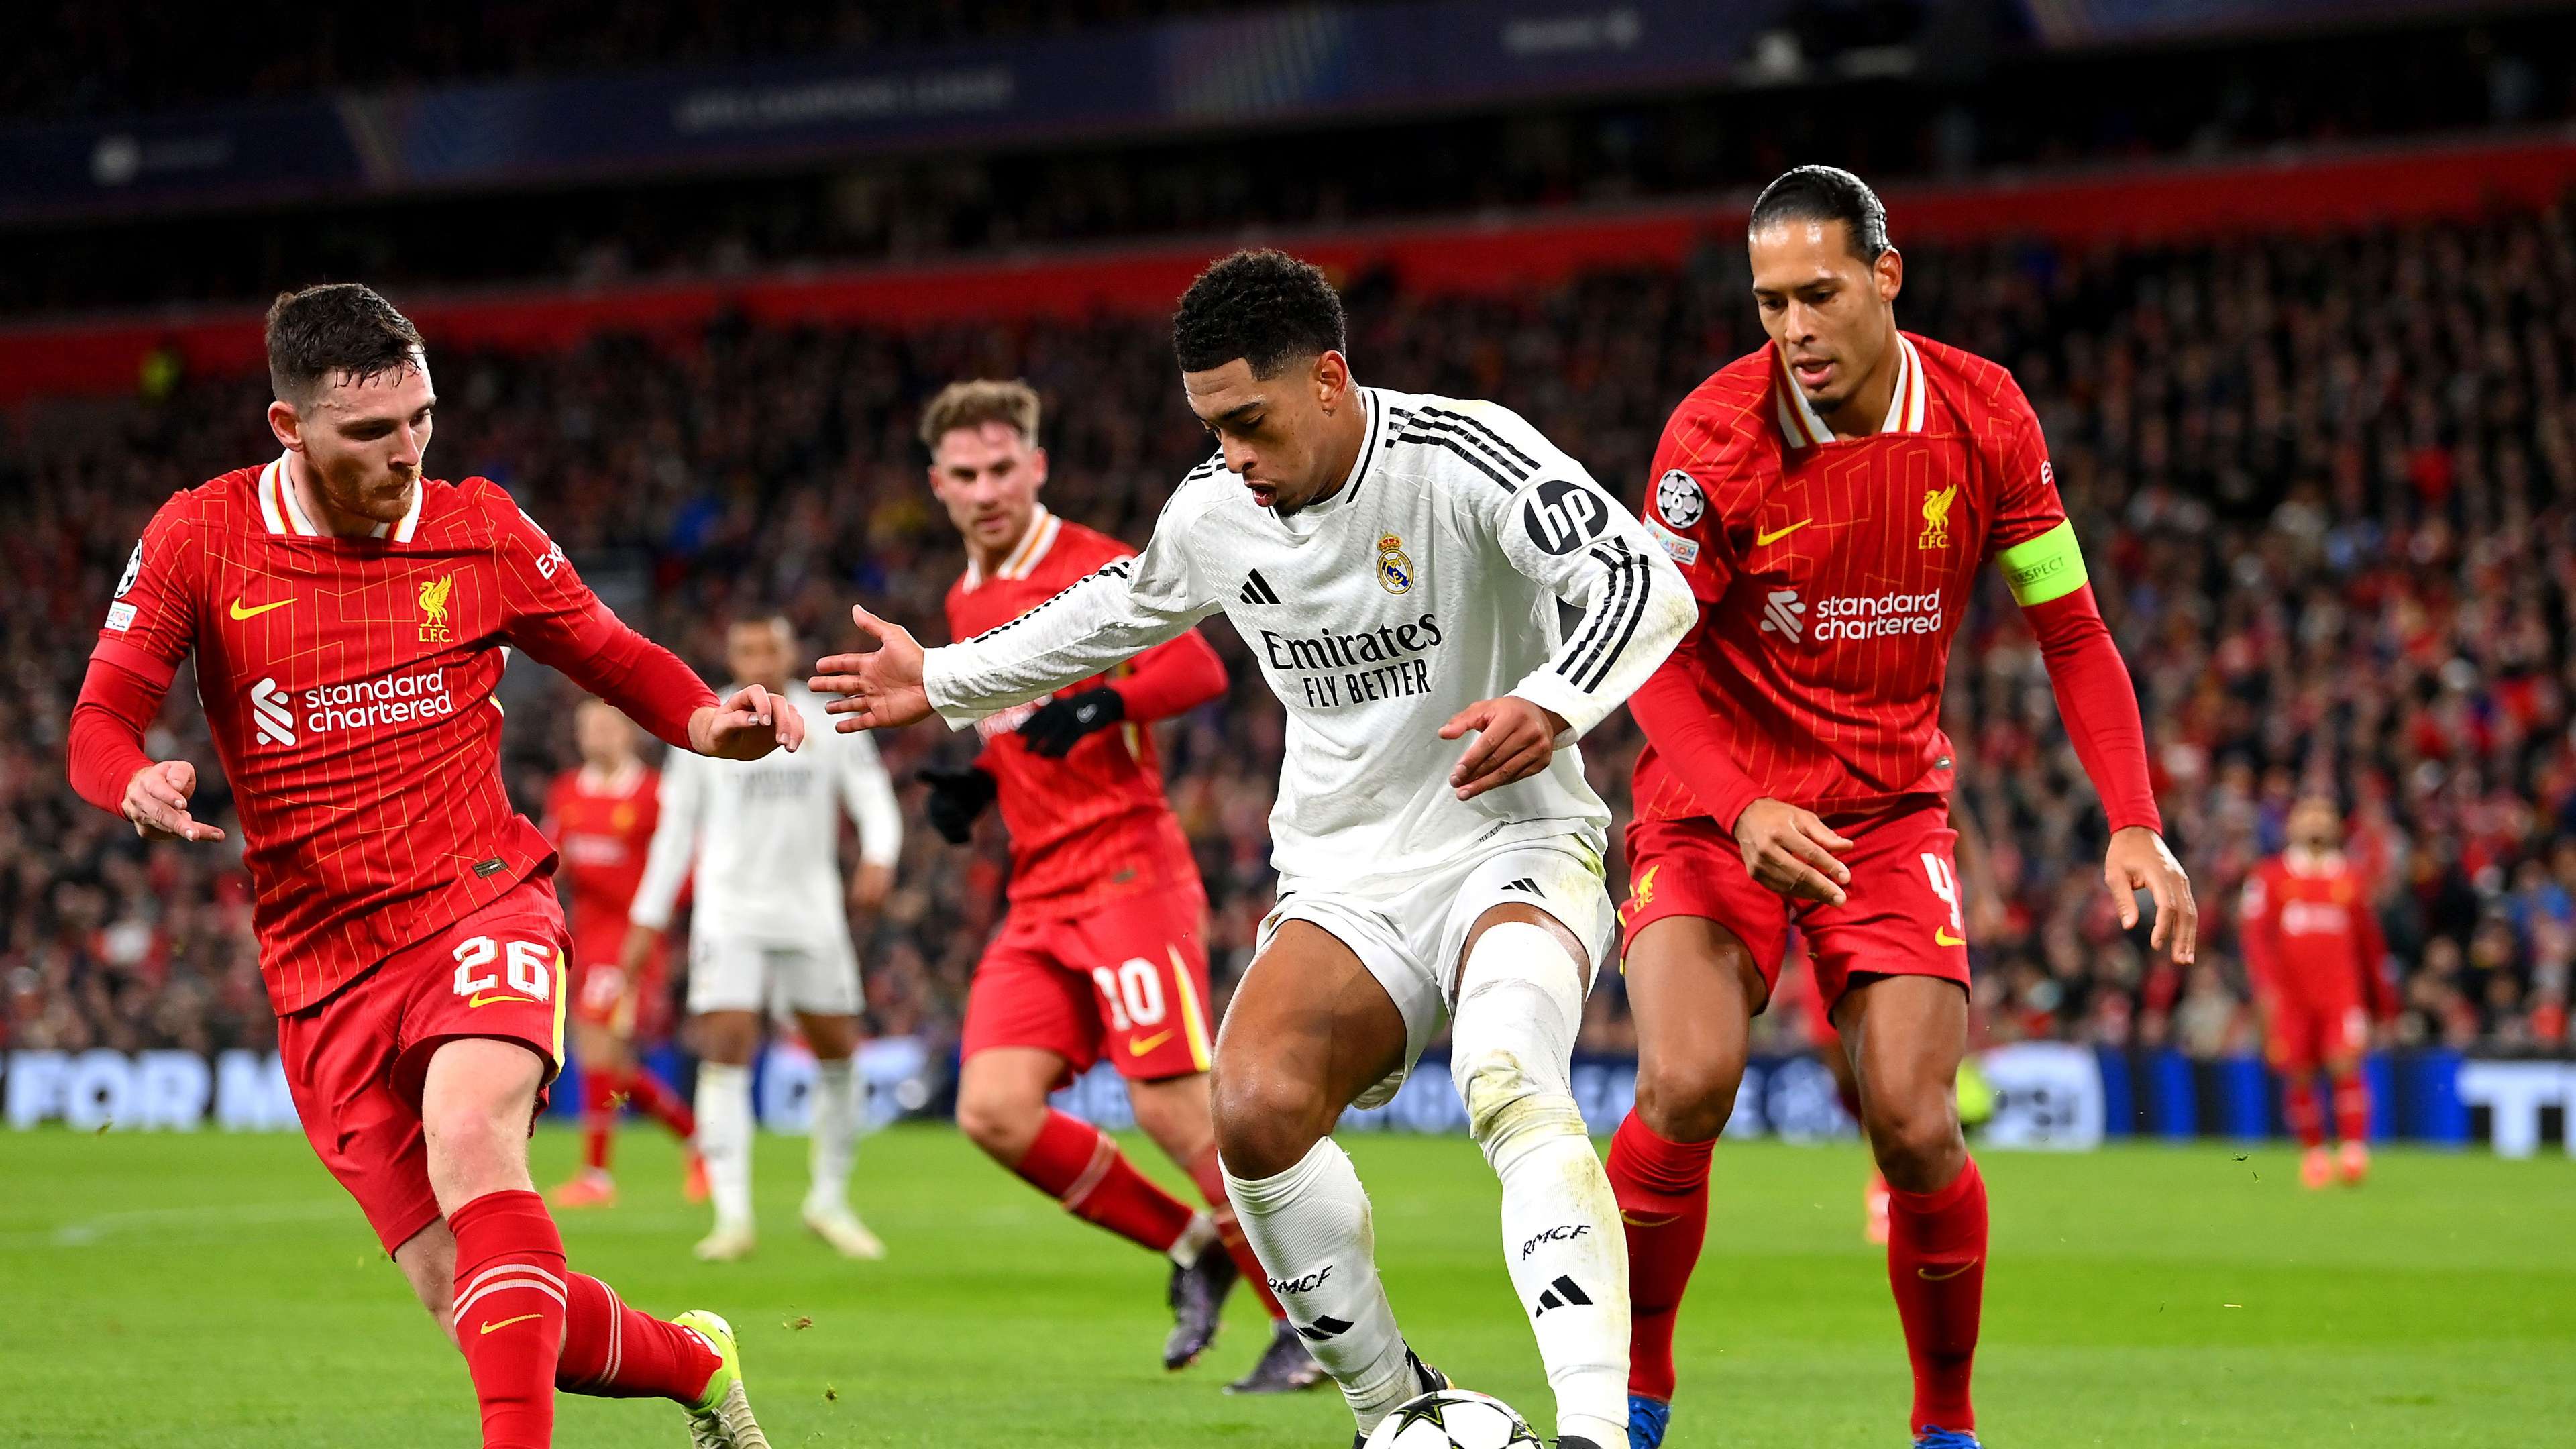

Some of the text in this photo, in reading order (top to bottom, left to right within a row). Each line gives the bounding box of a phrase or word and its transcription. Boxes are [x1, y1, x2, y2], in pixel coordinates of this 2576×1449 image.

[1528, 484, 1597, 553] hp
[1815, 608, 1942, 641] chartered
[1816, 588, 1941, 619] standard
[1259, 613, 1442, 669] Emirates
[305, 667, 443, 708] standard
[1303, 659, 1432, 708] FLY BETTER
[308, 690, 453, 733] chartered
[1921, 853, 1962, 931] 4
[452, 935, 551, 1002] 26
[1092, 956, 1167, 1032] 10
[1523, 1224, 1591, 1261] RMCF
